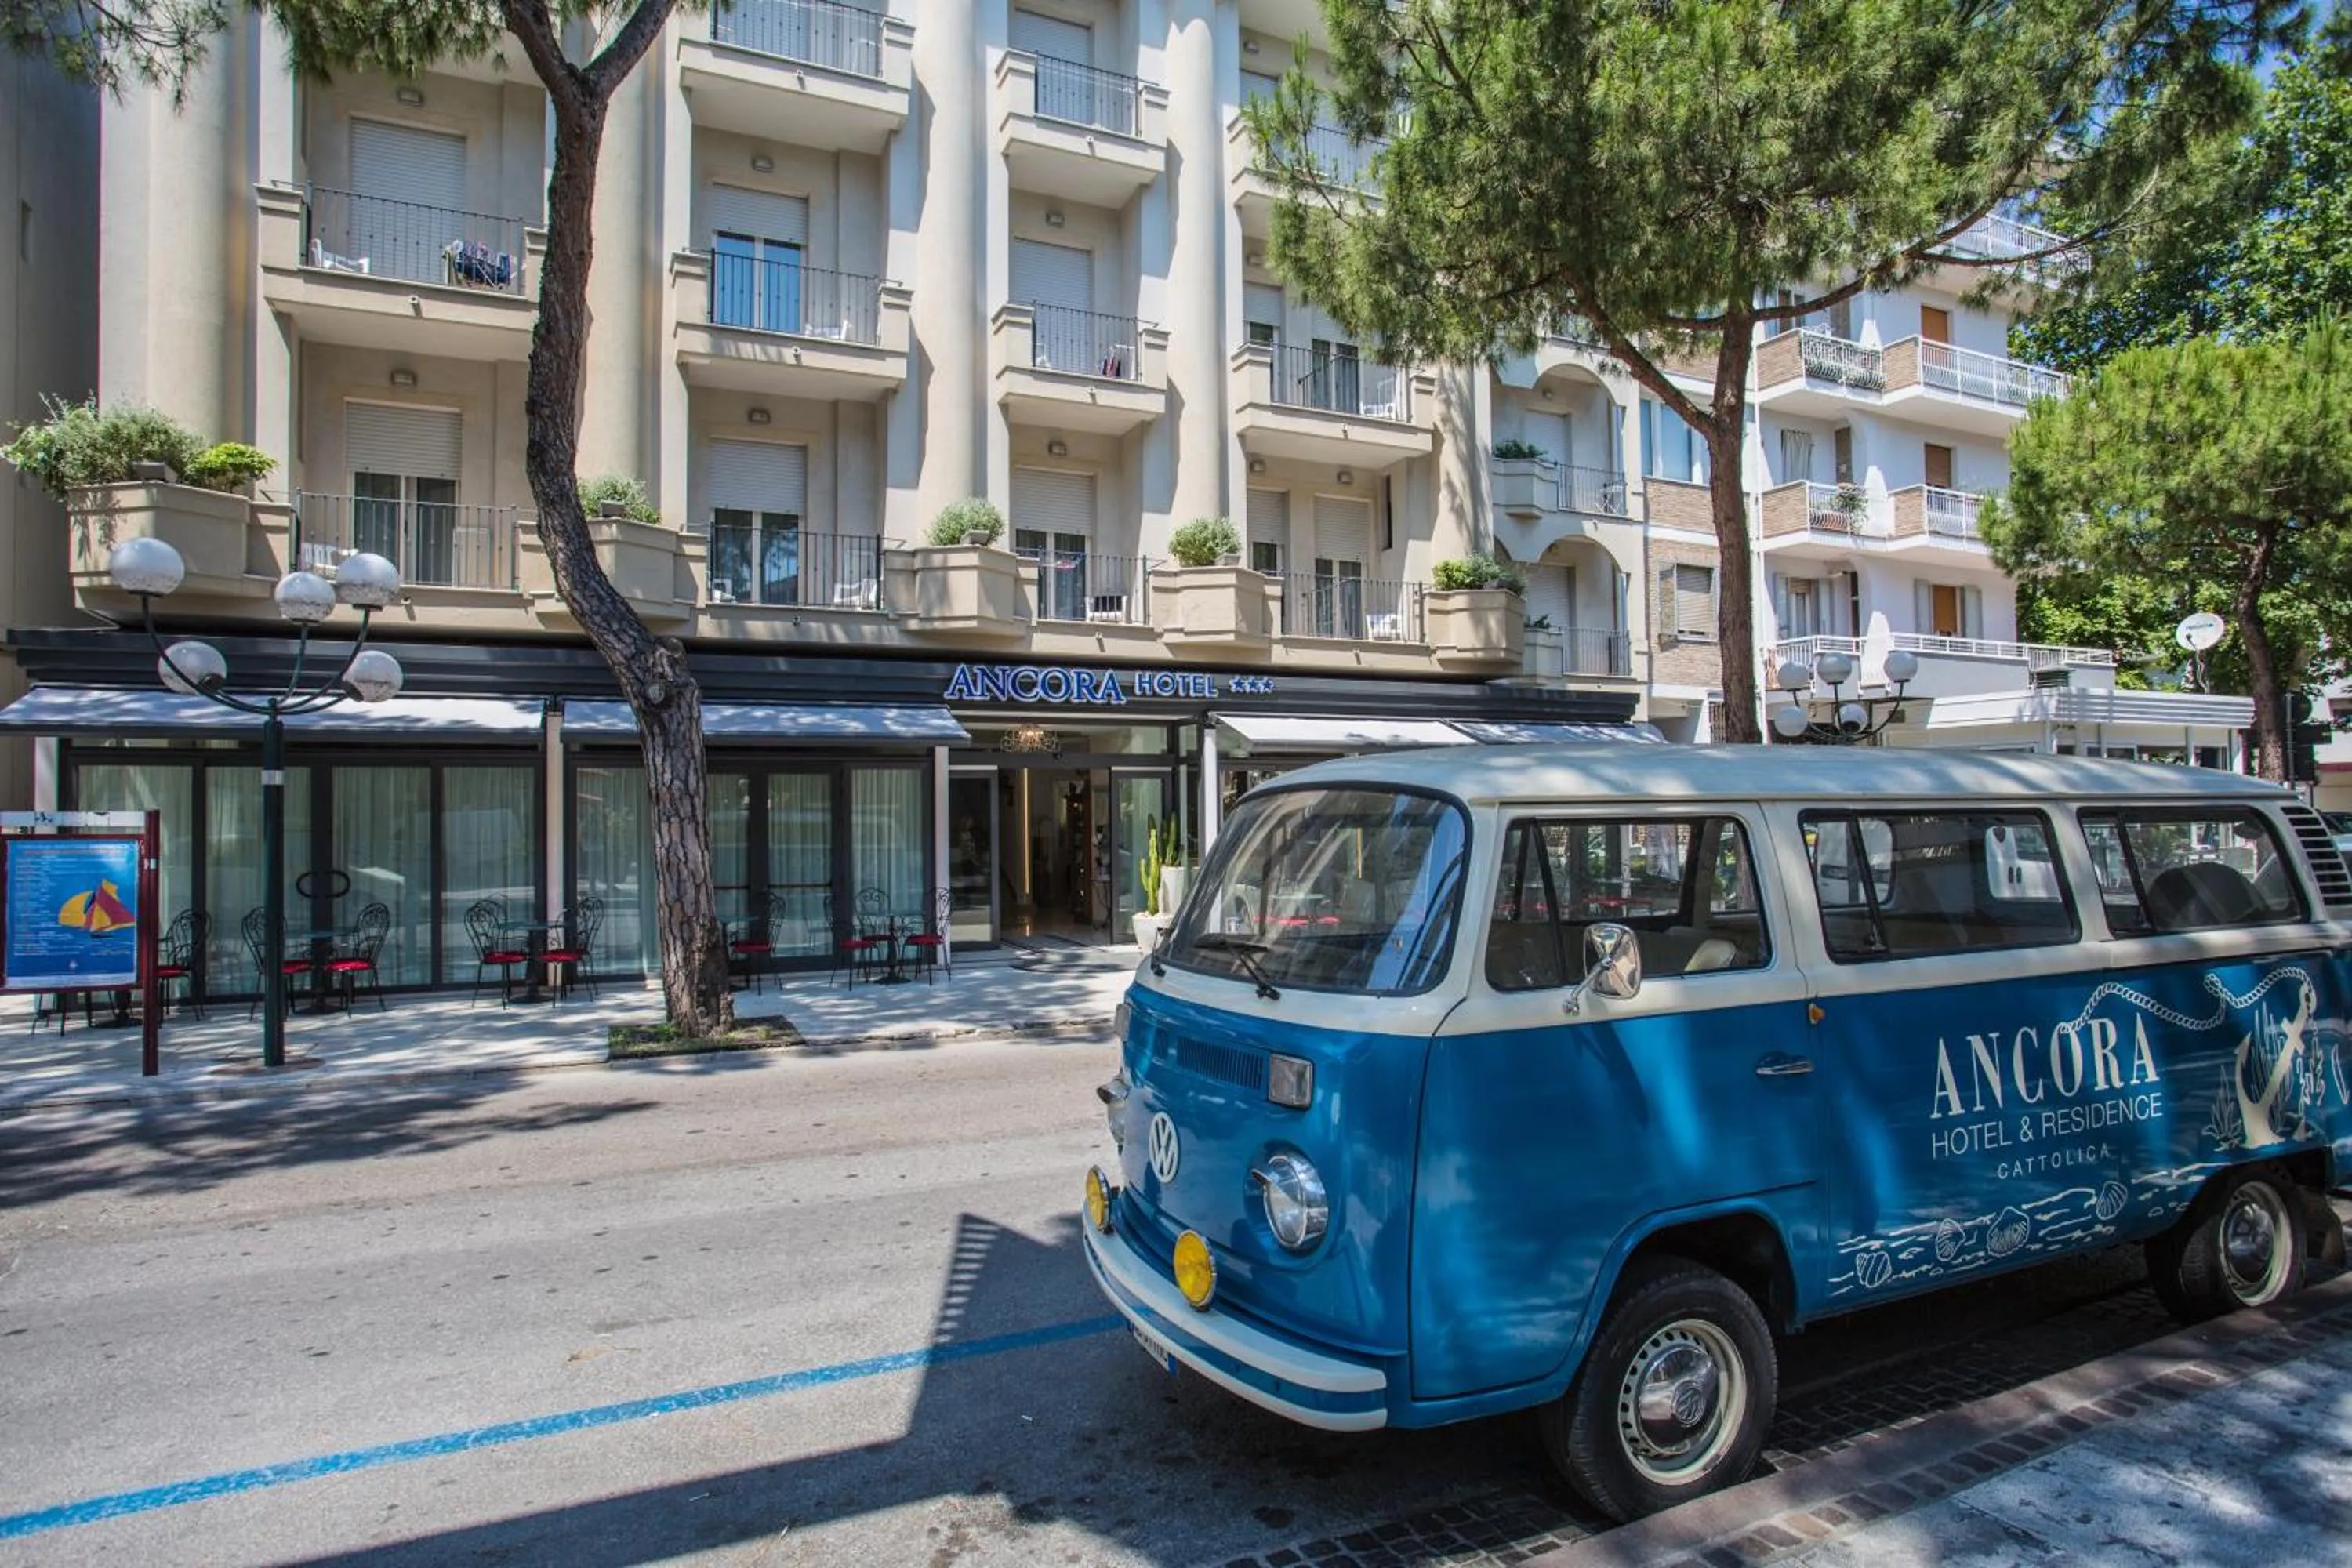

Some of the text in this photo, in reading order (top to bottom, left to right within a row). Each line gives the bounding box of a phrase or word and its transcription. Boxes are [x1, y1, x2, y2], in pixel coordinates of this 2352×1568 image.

[944, 664, 1218, 703] ANCORA HOTEL
[1930, 1011, 2160, 1119] ANCORA
[1932, 1093, 2164, 1159] HOTEL & RESIDENCE
[1998, 1142, 2110, 1180] CATTOLICA
